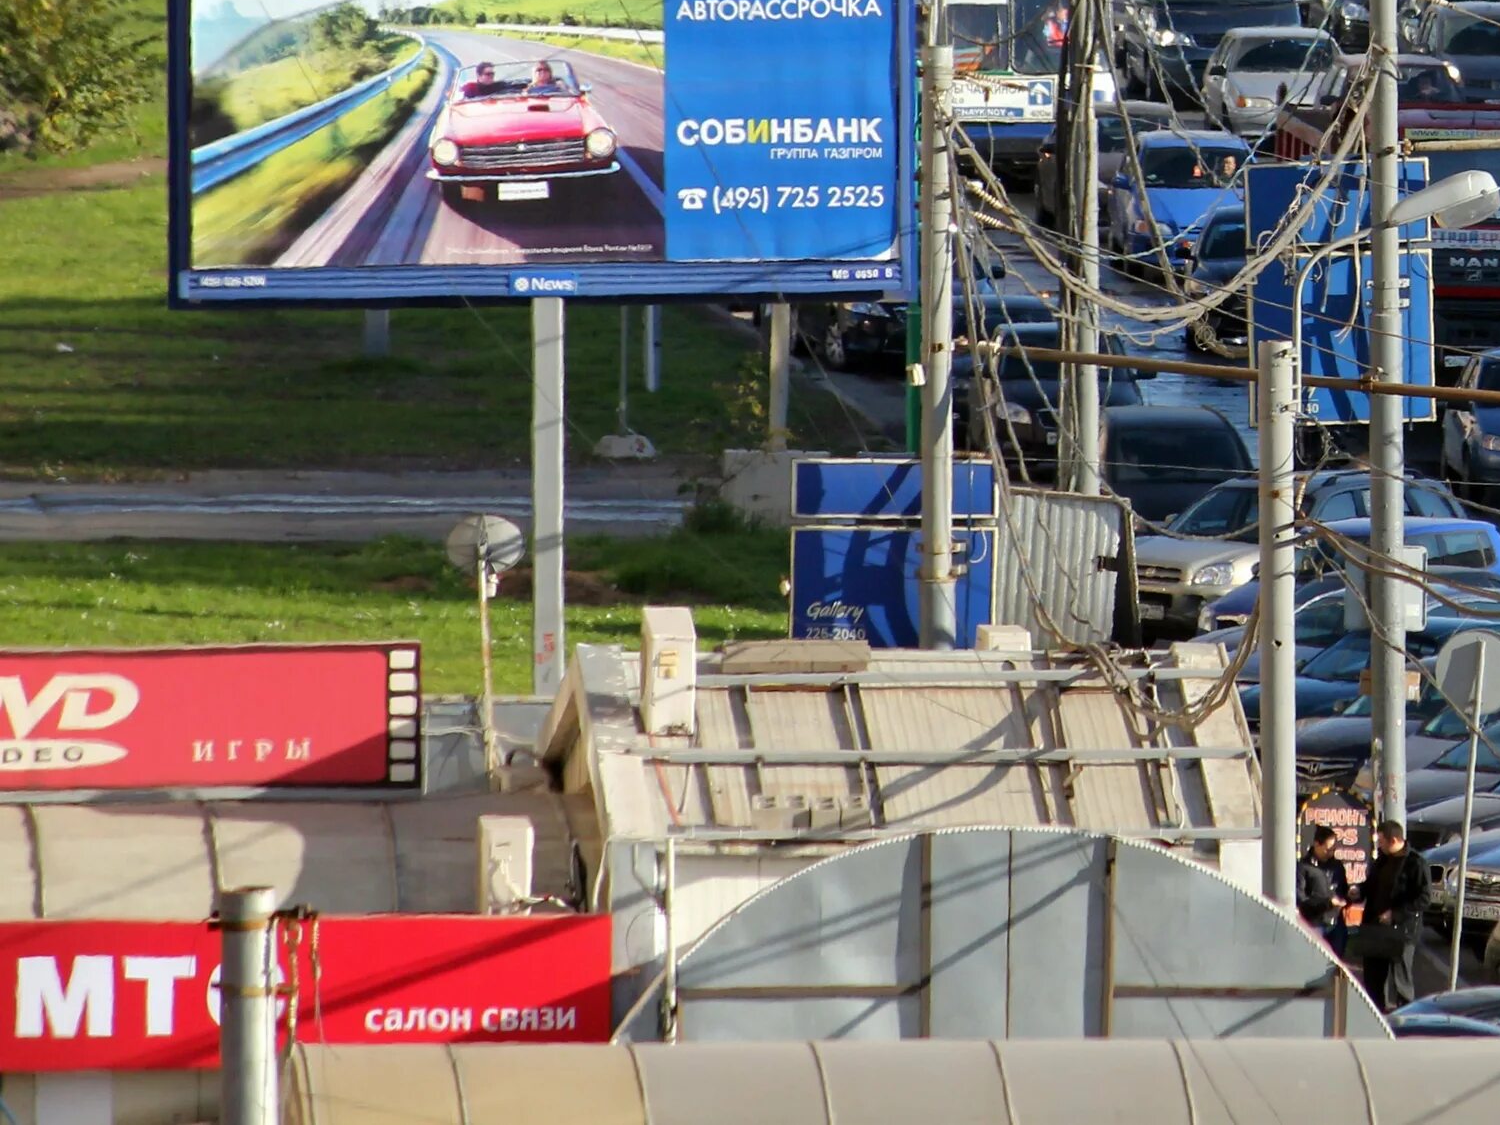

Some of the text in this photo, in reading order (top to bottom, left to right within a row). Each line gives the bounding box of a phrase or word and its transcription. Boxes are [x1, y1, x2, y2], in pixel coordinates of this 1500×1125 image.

[676, 117, 883, 146] СОБИНБАНК
[769, 147, 883, 160] ГРУППА ГАЗПРОМ
[711, 185, 885, 214] (495) 725 2525
[1449, 257, 1499, 268] MAN
[531, 277, 572, 291] News
[806, 600, 865, 623] Gallery
[805, 626, 866, 640] 225-2040
[0, 672, 140, 741] VD
[2, 746, 84, 764] DEO
[191, 737, 313, 763] ИГРЫ
[1305, 807, 1369, 826] РЕМОНТ
[1333, 827, 1359, 845] PS
[364, 1004, 578, 1033] салон связи
